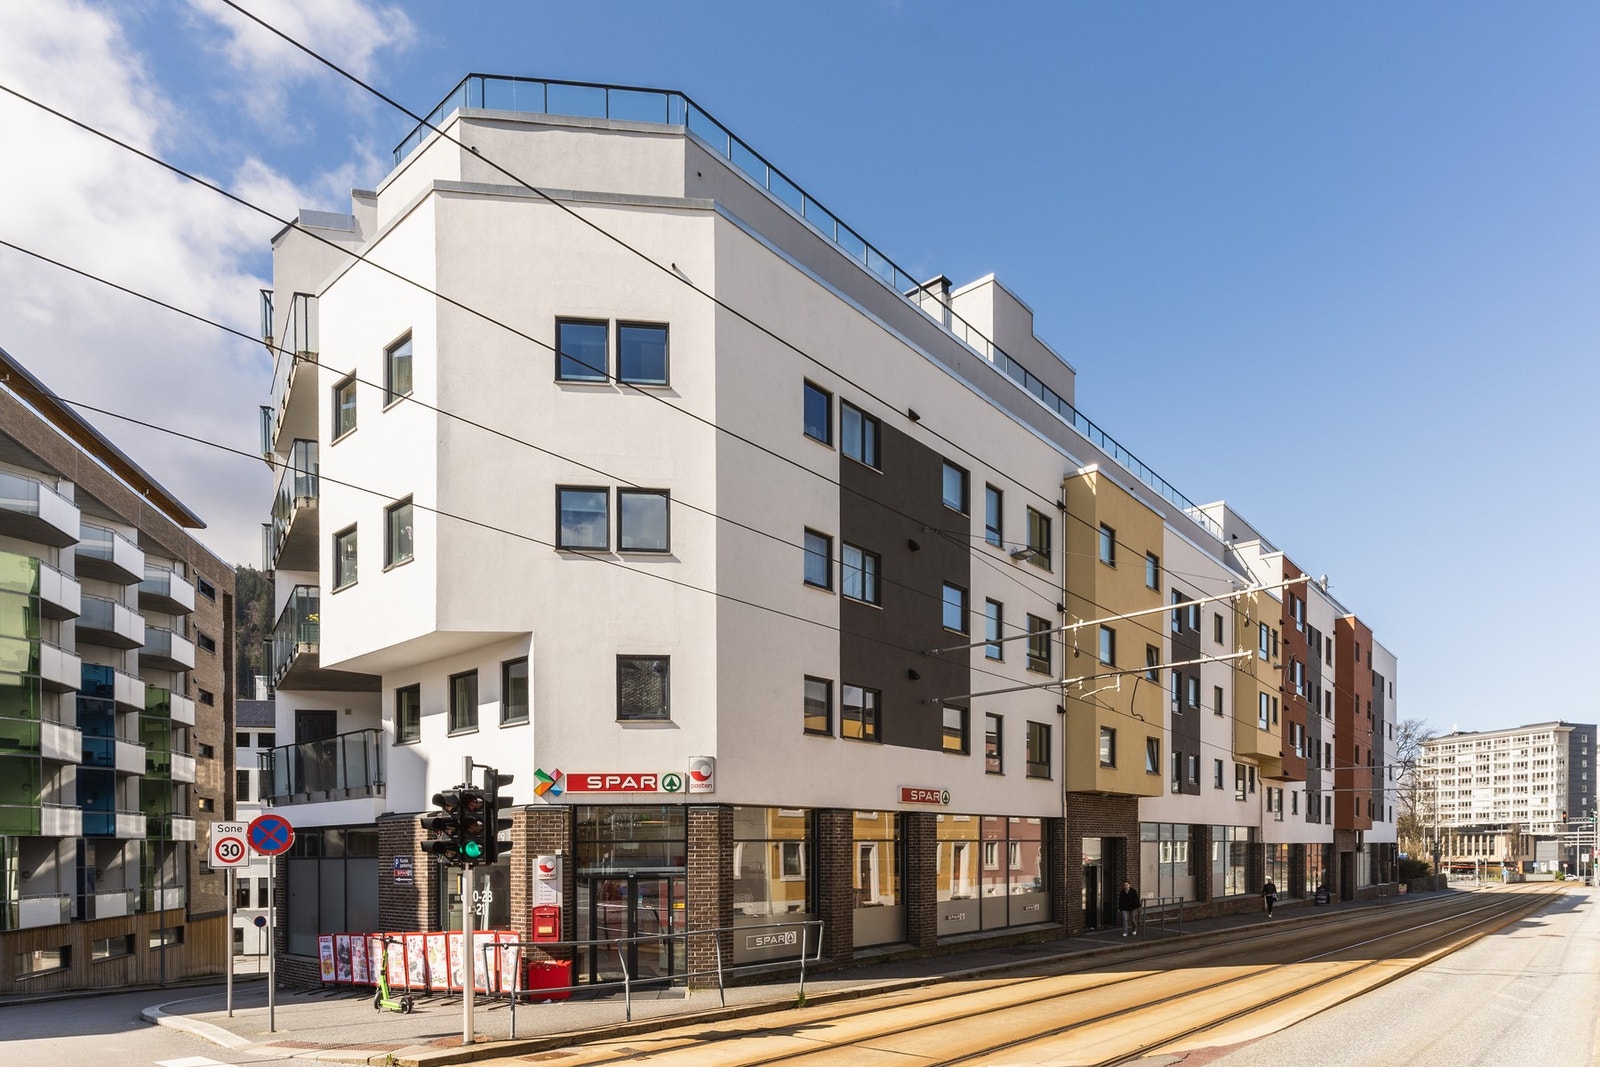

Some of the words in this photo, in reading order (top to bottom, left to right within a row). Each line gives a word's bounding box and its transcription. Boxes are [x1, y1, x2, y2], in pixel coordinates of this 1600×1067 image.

[587, 776, 656, 789] SPAR
[690, 782, 712, 790] posten
[911, 790, 940, 801] SPAR
[217, 824, 243, 833] Sone
[221, 843, 240, 857] 30
[756, 935, 785, 946] SPAR
